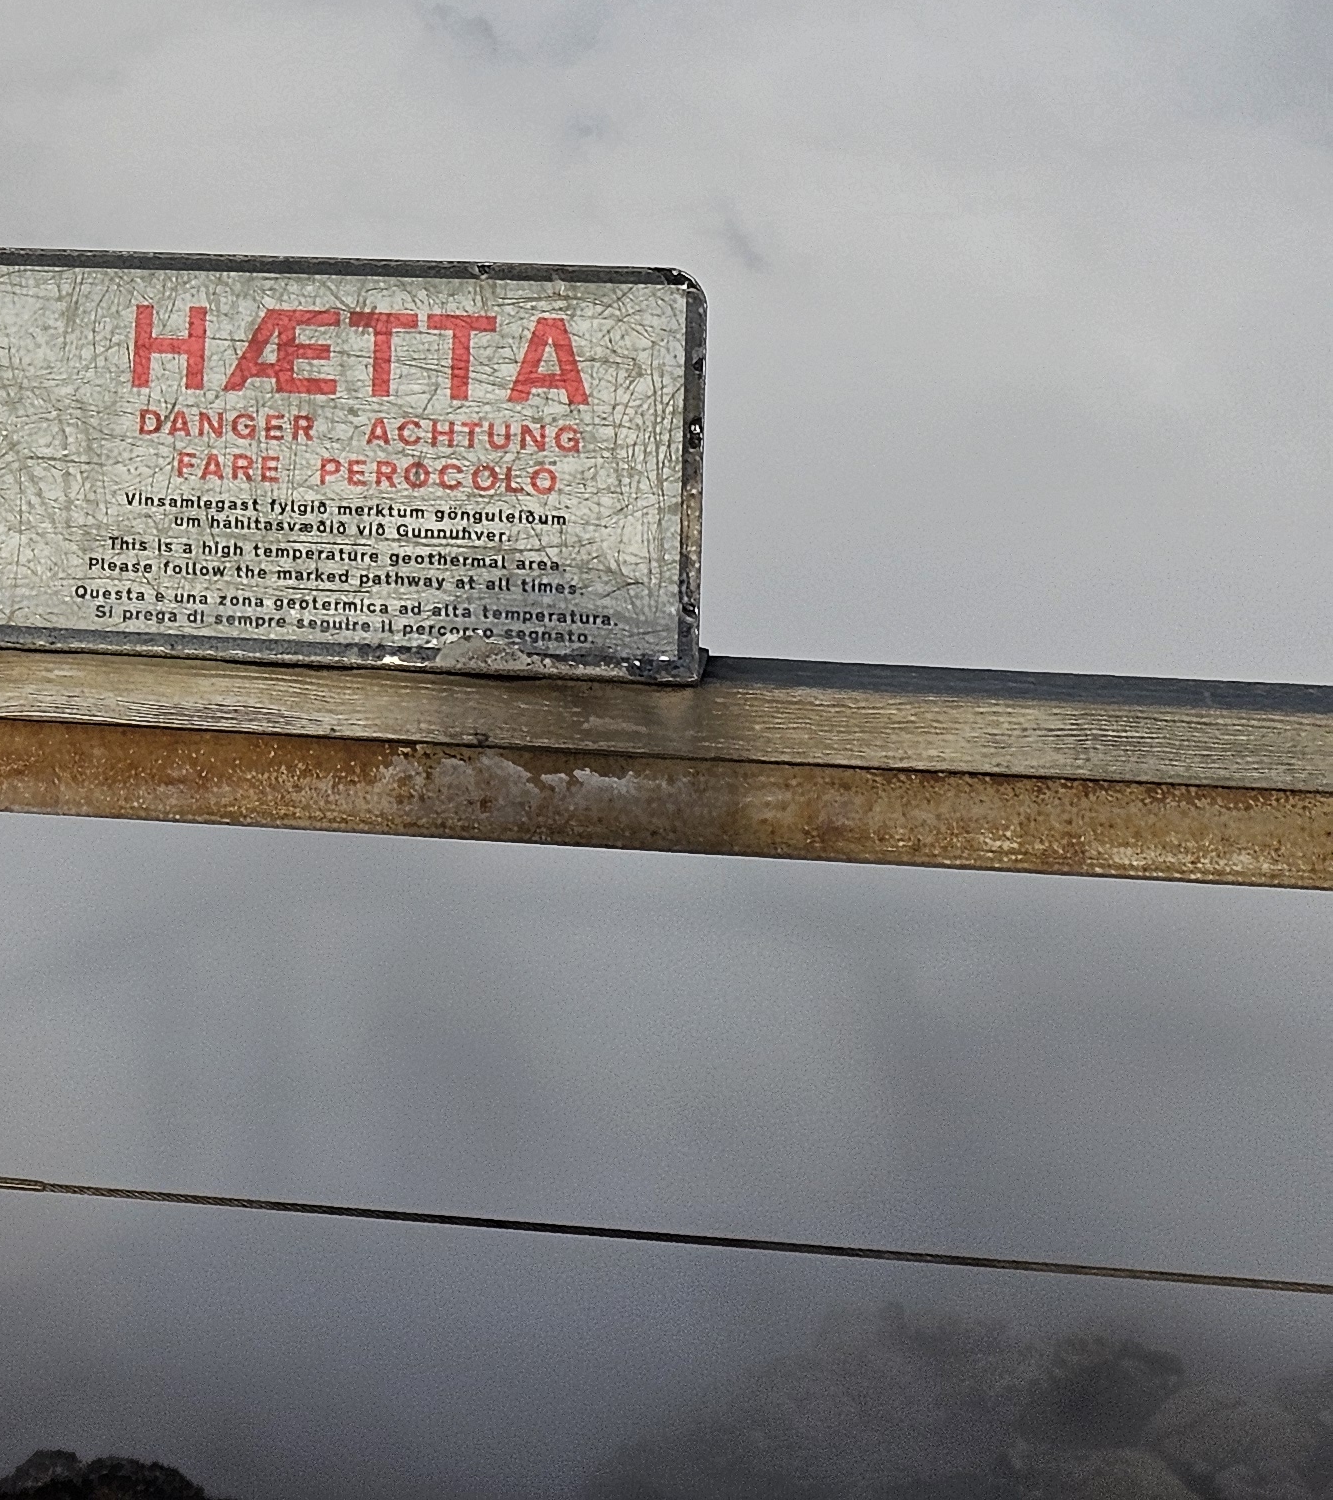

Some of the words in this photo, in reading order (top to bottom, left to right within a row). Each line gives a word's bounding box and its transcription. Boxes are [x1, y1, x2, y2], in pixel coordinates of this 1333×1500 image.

[132, 304, 589, 405] HÆTTA
[137, 409, 315, 443] DANGER
[366, 417, 581, 453] ACHTUNG
[176, 452, 281, 484] FARE
[125, 492, 260, 513] Vinsamlegast
[270, 500, 328, 516] fylgið
[337, 504, 425, 519] merktum
[434, 507, 567, 526] gönguleiðum
[174, 516, 201, 528] um
[210, 515, 347, 535] háhitasvæðið
[357, 522, 386, 537] við
[396, 523, 512, 543] Gunnuhver.
[109, 536, 148, 551] This
[157, 538, 173, 554] is
[182, 542, 193, 554] a
[202, 541, 244, 559] high
[253, 543, 379, 563] temperature
[389, 549, 506, 569] geothermal
[516, 557, 567, 573] area.
[88, 557, 153, 574] Please
[163, 561, 227, 577] follow
[235, 565, 267, 579] the
[276, 567, 348, 584] marked
[359, 572, 445, 590] pathway
[456, 576, 476, 590] at
[486, 577, 511, 592] all
[521, 578, 585, 596] times.
[74, 585, 145, 601] Questa
[174, 592, 208, 605] una
[218, 595, 264, 608] zona
[273, 597, 389, 615] geotermica
[399, 601, 423, 615] ad
[432, 603, 472, 618] alta
[482, 605, 619, 627] temperatura.
[95, 605, 113, 618] Si
[122, 608, 178, 624] prega
[187, 609, 205, 624] di
[214, 613, 286, 630] sempre
[296, 615, 371, 633] seguire
[381, 619, 393, 633] il
